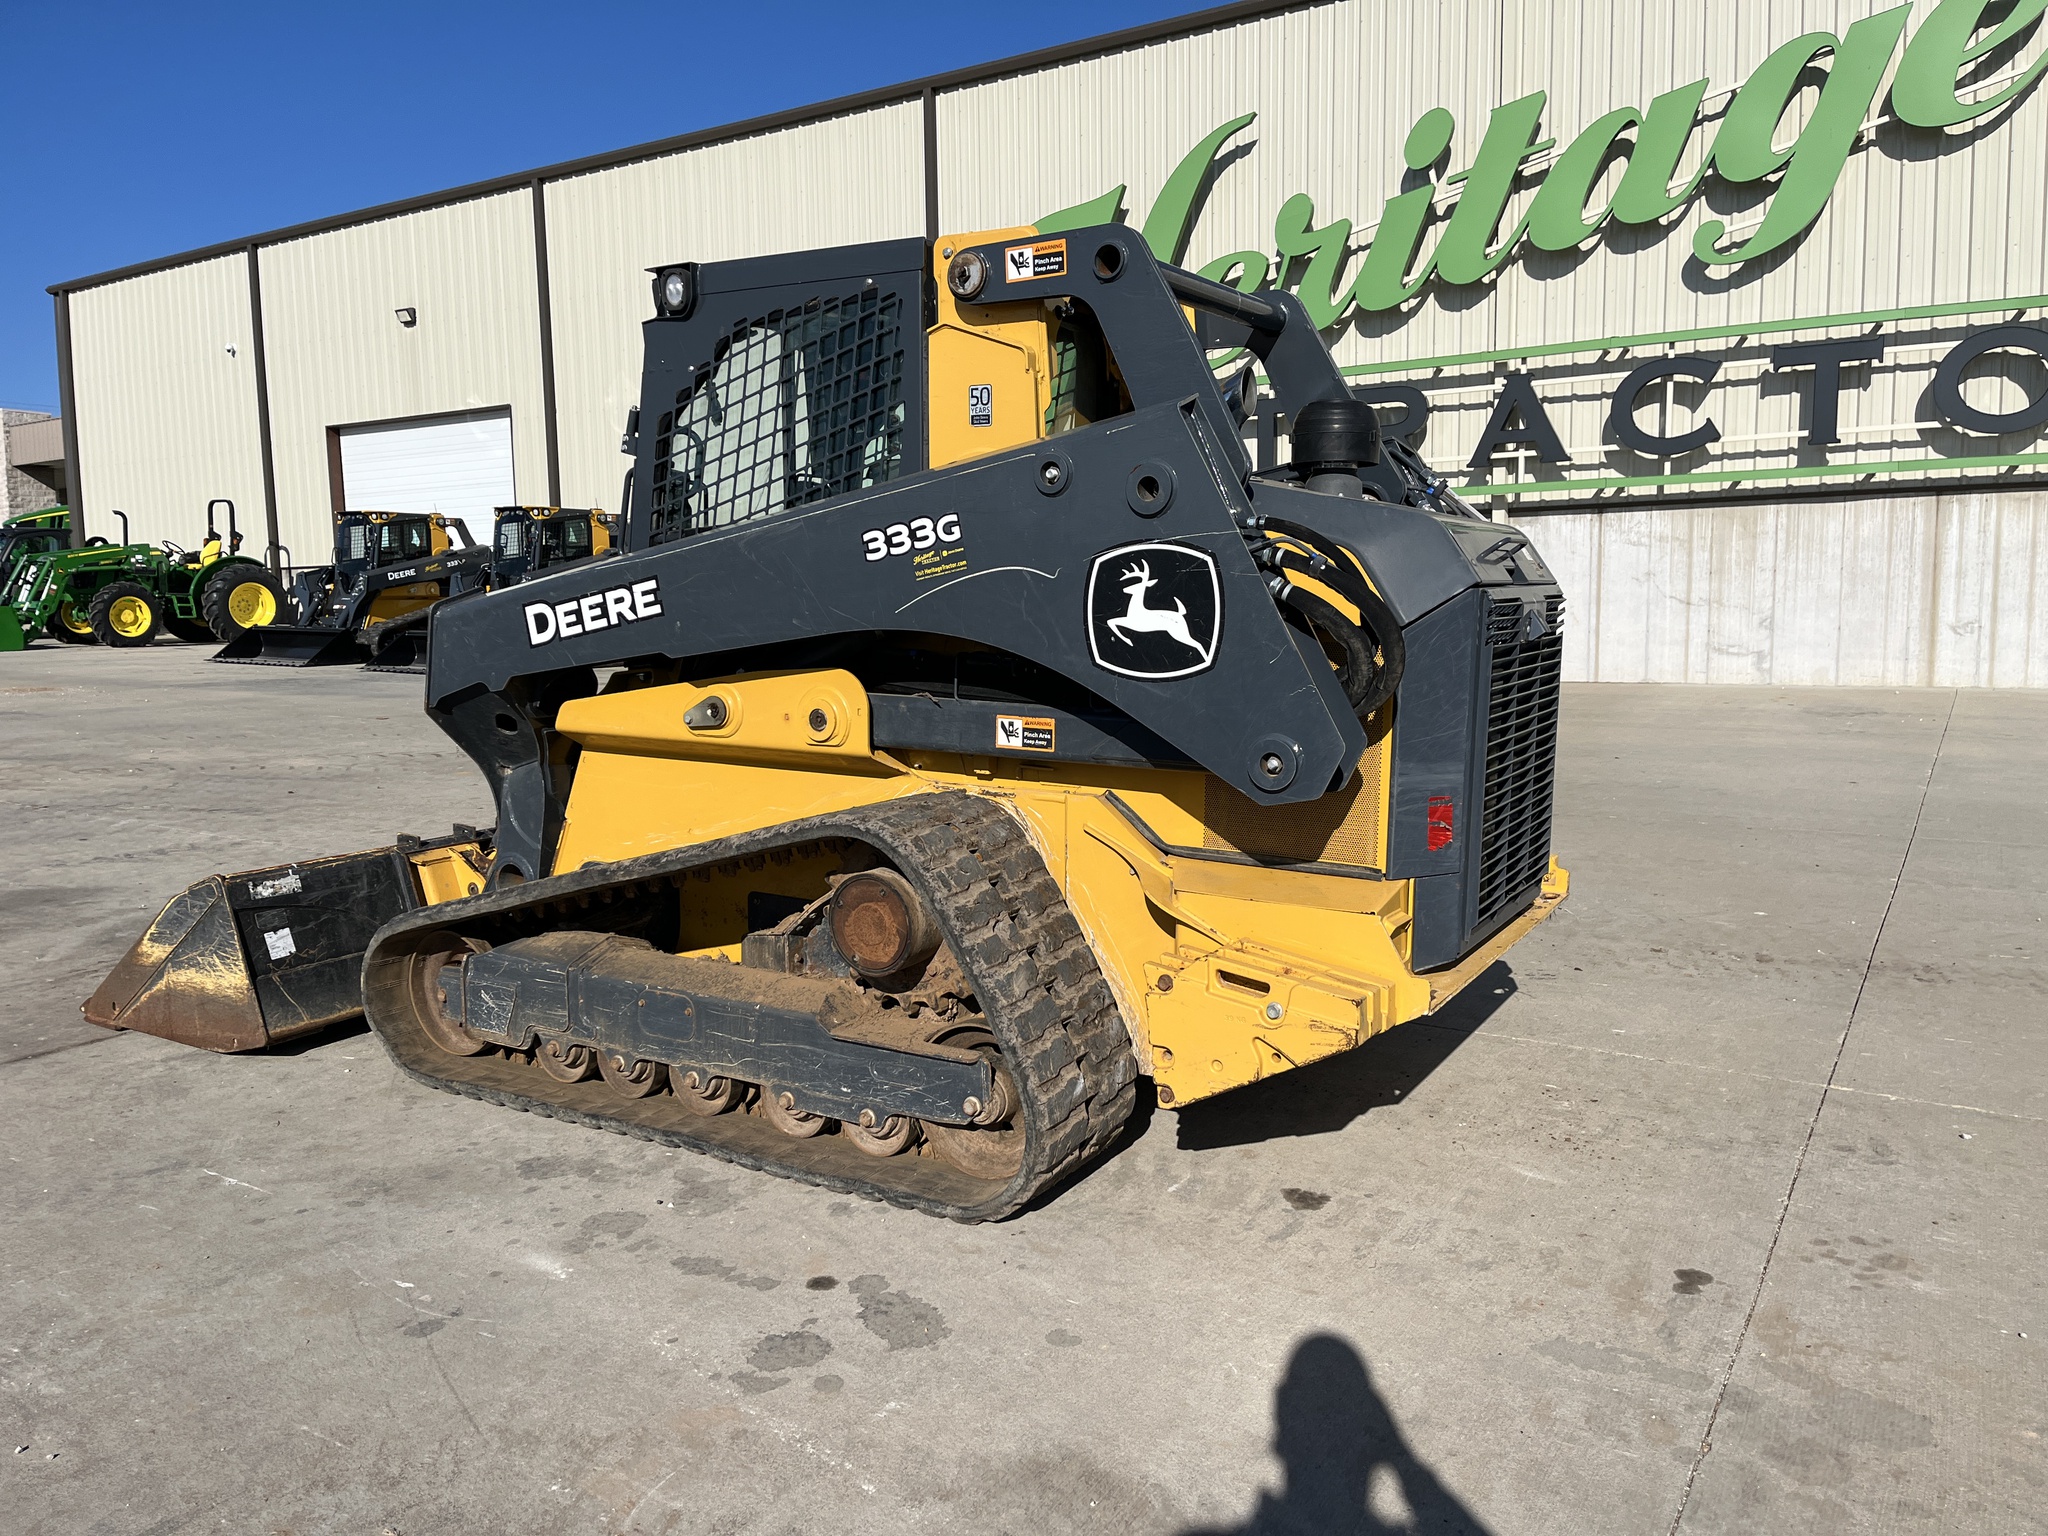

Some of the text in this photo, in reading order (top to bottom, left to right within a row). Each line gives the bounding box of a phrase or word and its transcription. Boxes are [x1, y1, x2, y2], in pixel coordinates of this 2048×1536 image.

[1040, 243, 1063, 251] WARNING
[1034, 257, 1050, 266] Pinch
[970, 386, 991, 407] 50
[971, 406, 991, 414] YEARS
[862, 512, 962, 561] 333G
[924, 560, 967, 575] HeritageTractor.com
[387, 568, 417, 581] DEERE
[524, 578, 662, 646] DEERE
[1023, 731, 1039, 739] Pinch
